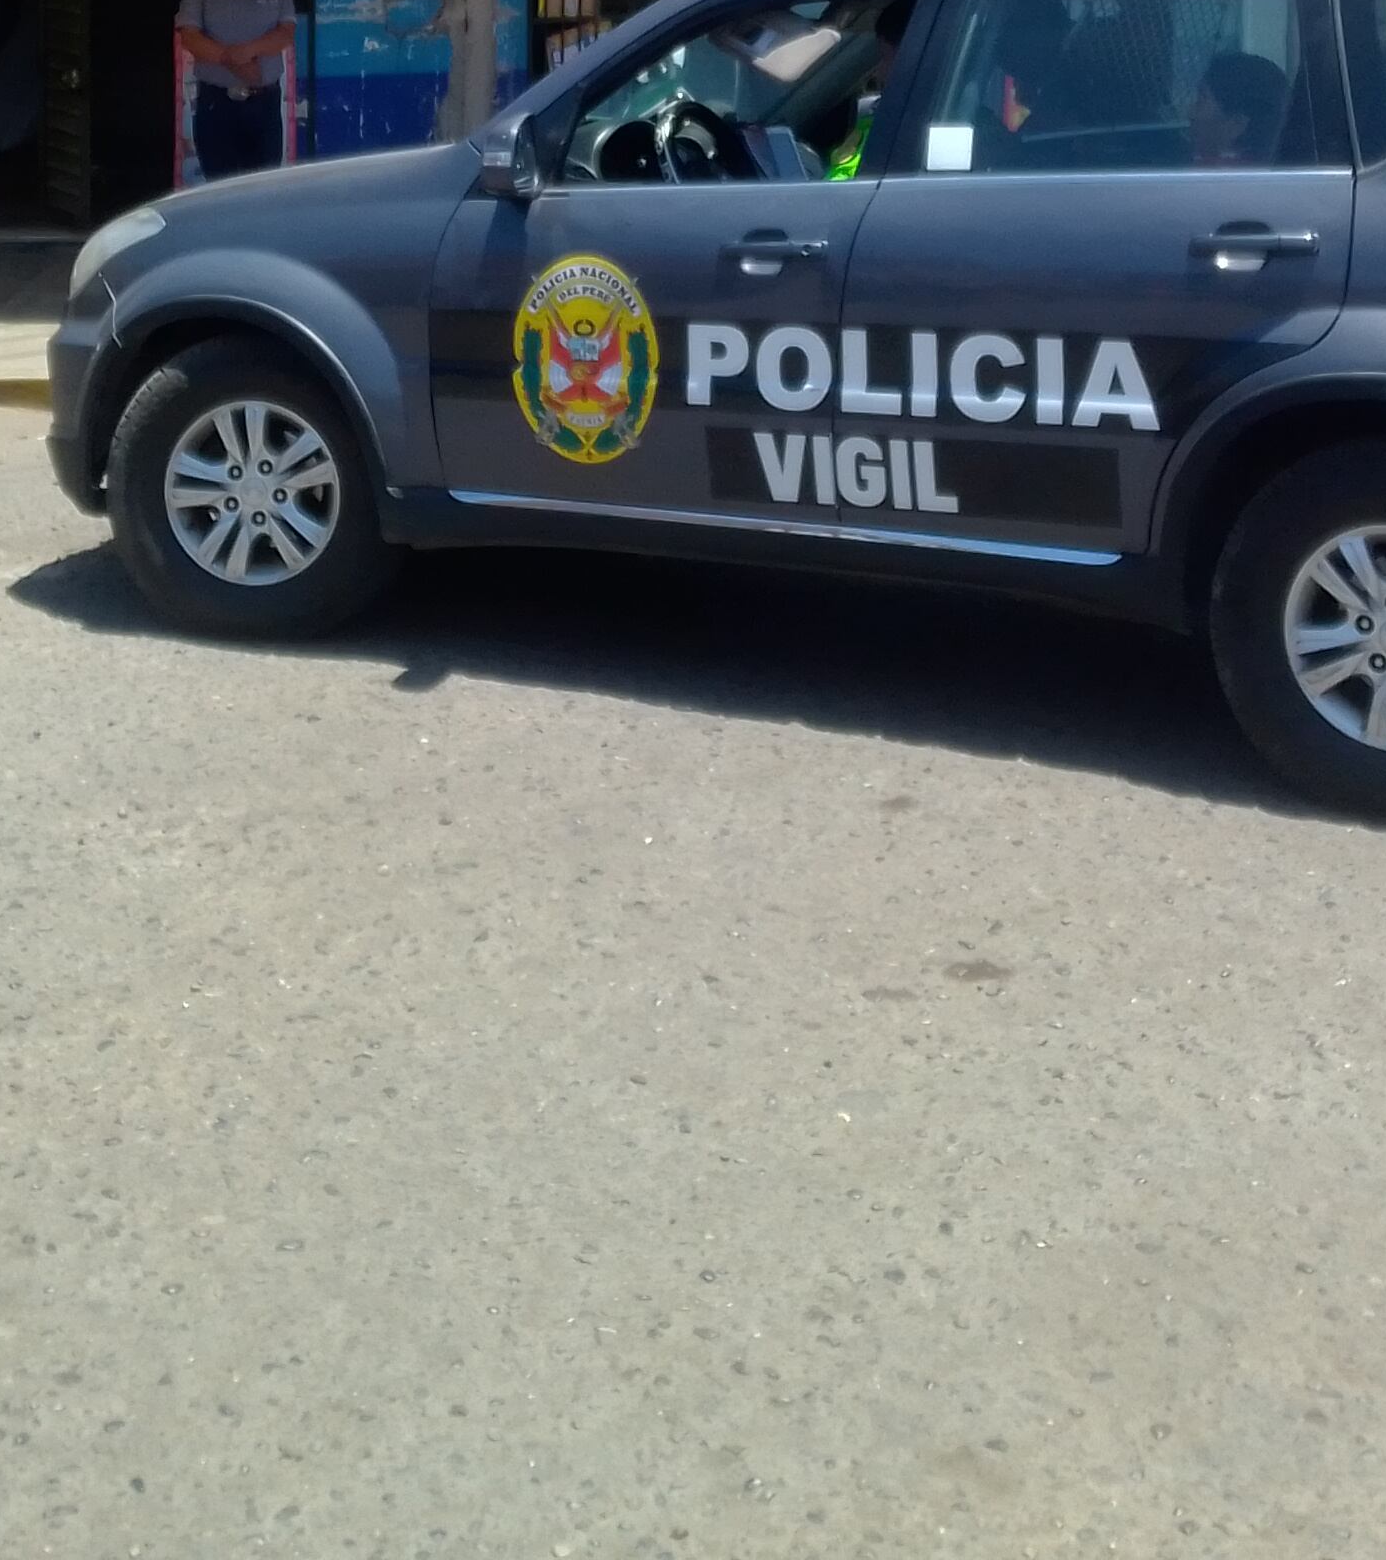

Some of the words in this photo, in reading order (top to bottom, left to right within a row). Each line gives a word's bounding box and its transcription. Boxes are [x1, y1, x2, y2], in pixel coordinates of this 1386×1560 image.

[529, 266, 576, 311] POLICIA
[578, 266, 638, 315] NACIONAL
[685, 323, 1162, 433] POLICIA
[752, 431, 960, 515] VIGIL
